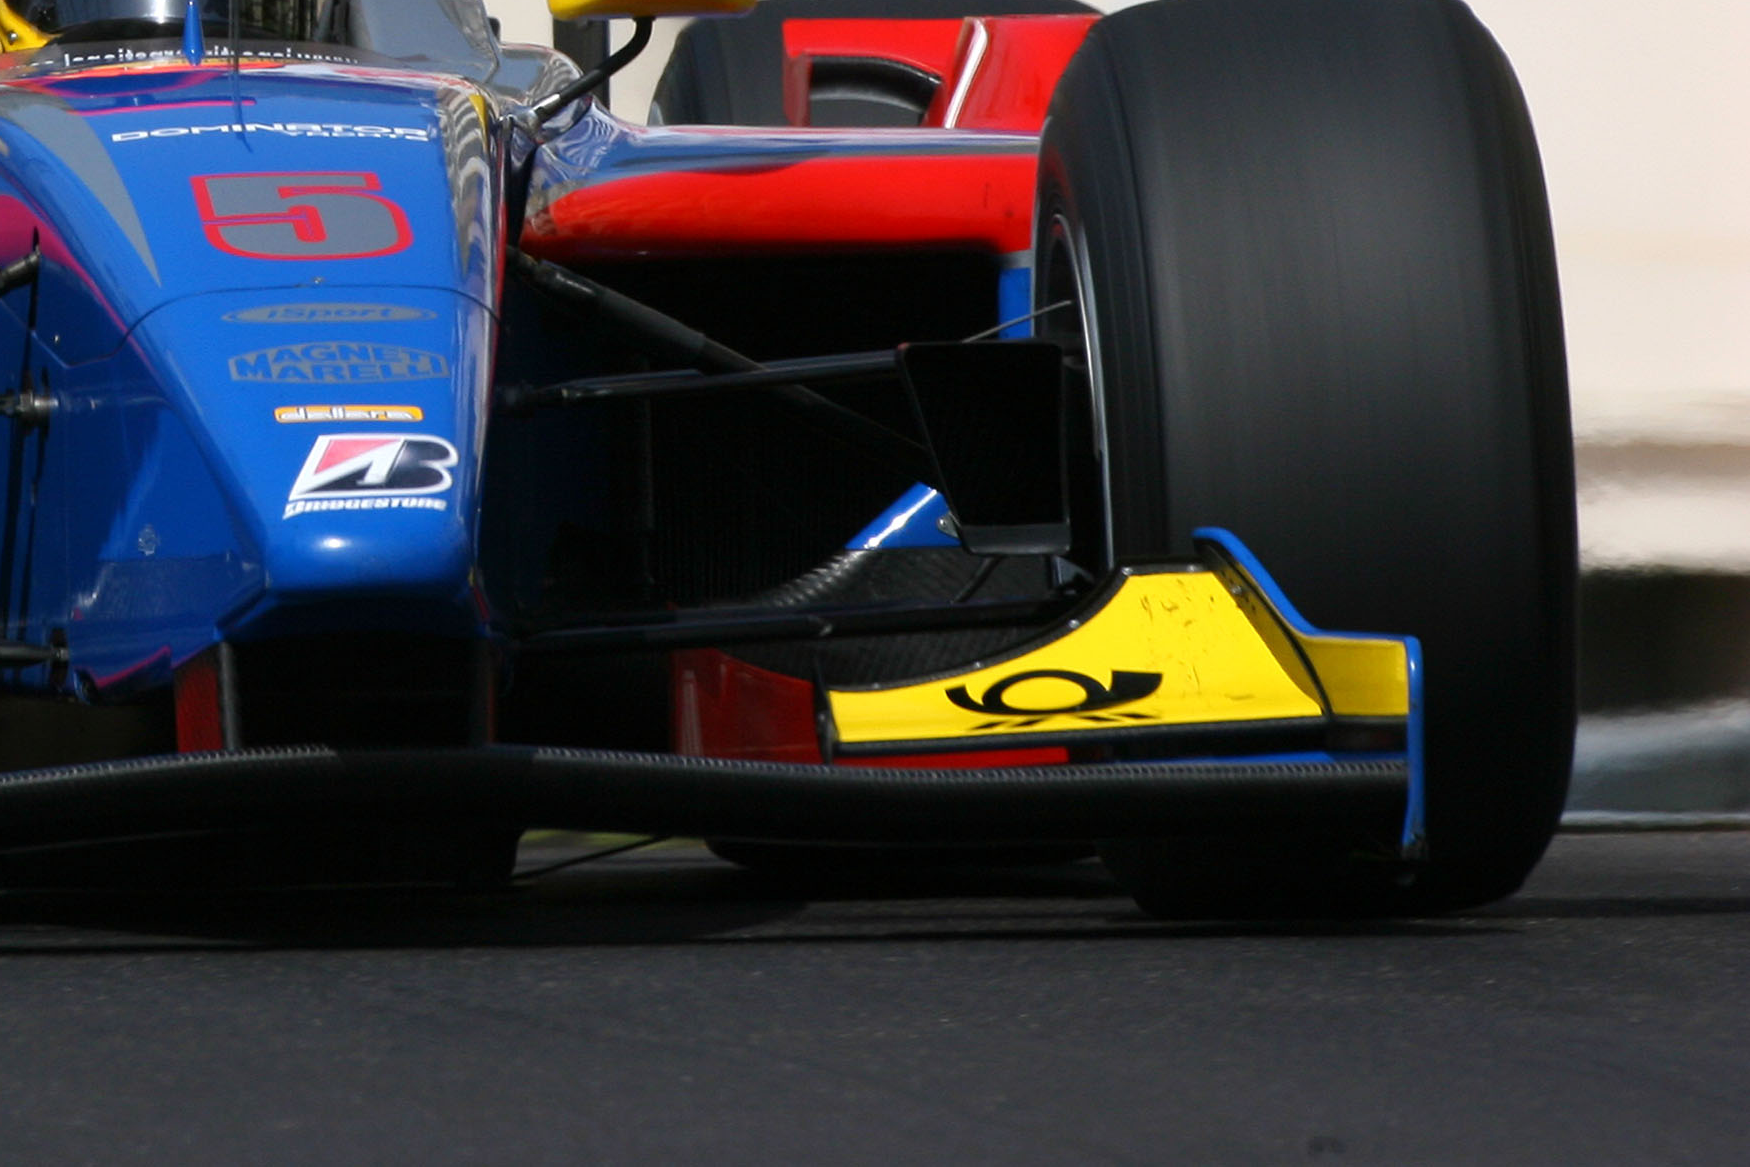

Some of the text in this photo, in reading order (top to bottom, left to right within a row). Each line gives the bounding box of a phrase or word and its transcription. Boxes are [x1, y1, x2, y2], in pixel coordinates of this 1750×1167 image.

[111, 122, 428, 141] DOMINATOR
[190, 171, 414, 261] 5
[267, 307, 393, 320] iSport
[231, 343, 446, 366] MAGNETI
[279, 405, 414, 421] dallara
[283, 497, 447, 520] BRIDGESTONE
